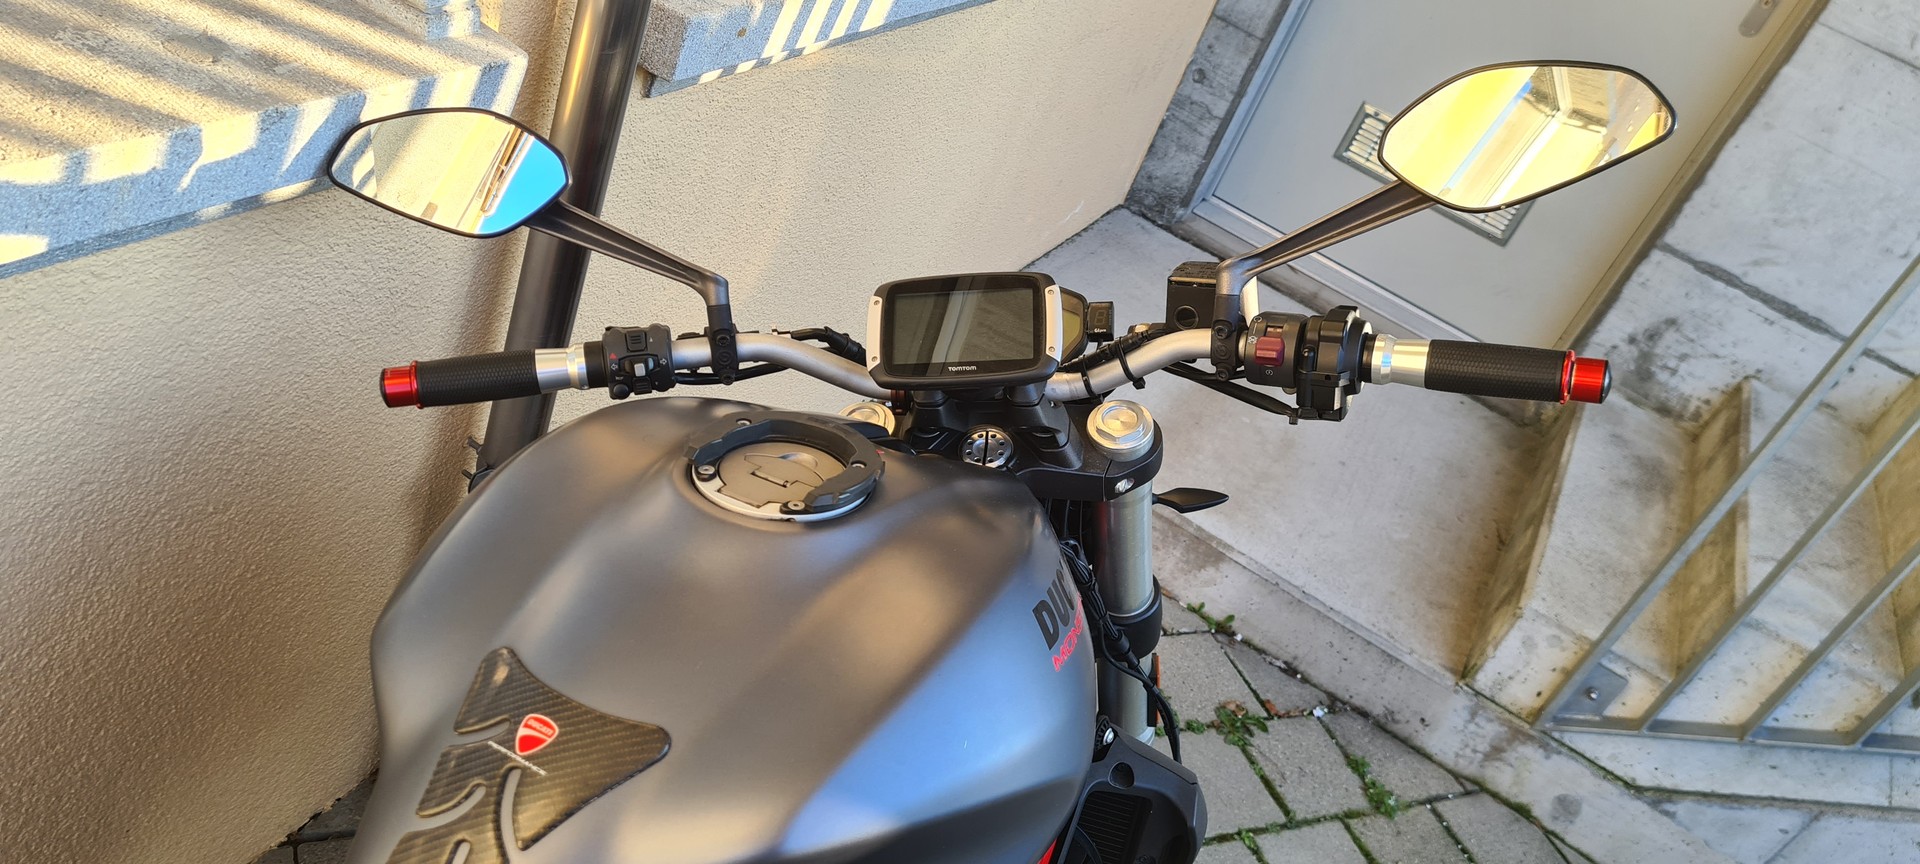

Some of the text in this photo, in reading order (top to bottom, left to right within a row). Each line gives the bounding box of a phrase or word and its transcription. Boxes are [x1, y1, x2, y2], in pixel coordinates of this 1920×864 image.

[1032, 560, 1075, 651] DUC
[1052, 592, 1083, 672] MON
[526, 718, 554, 737] DUCATI
